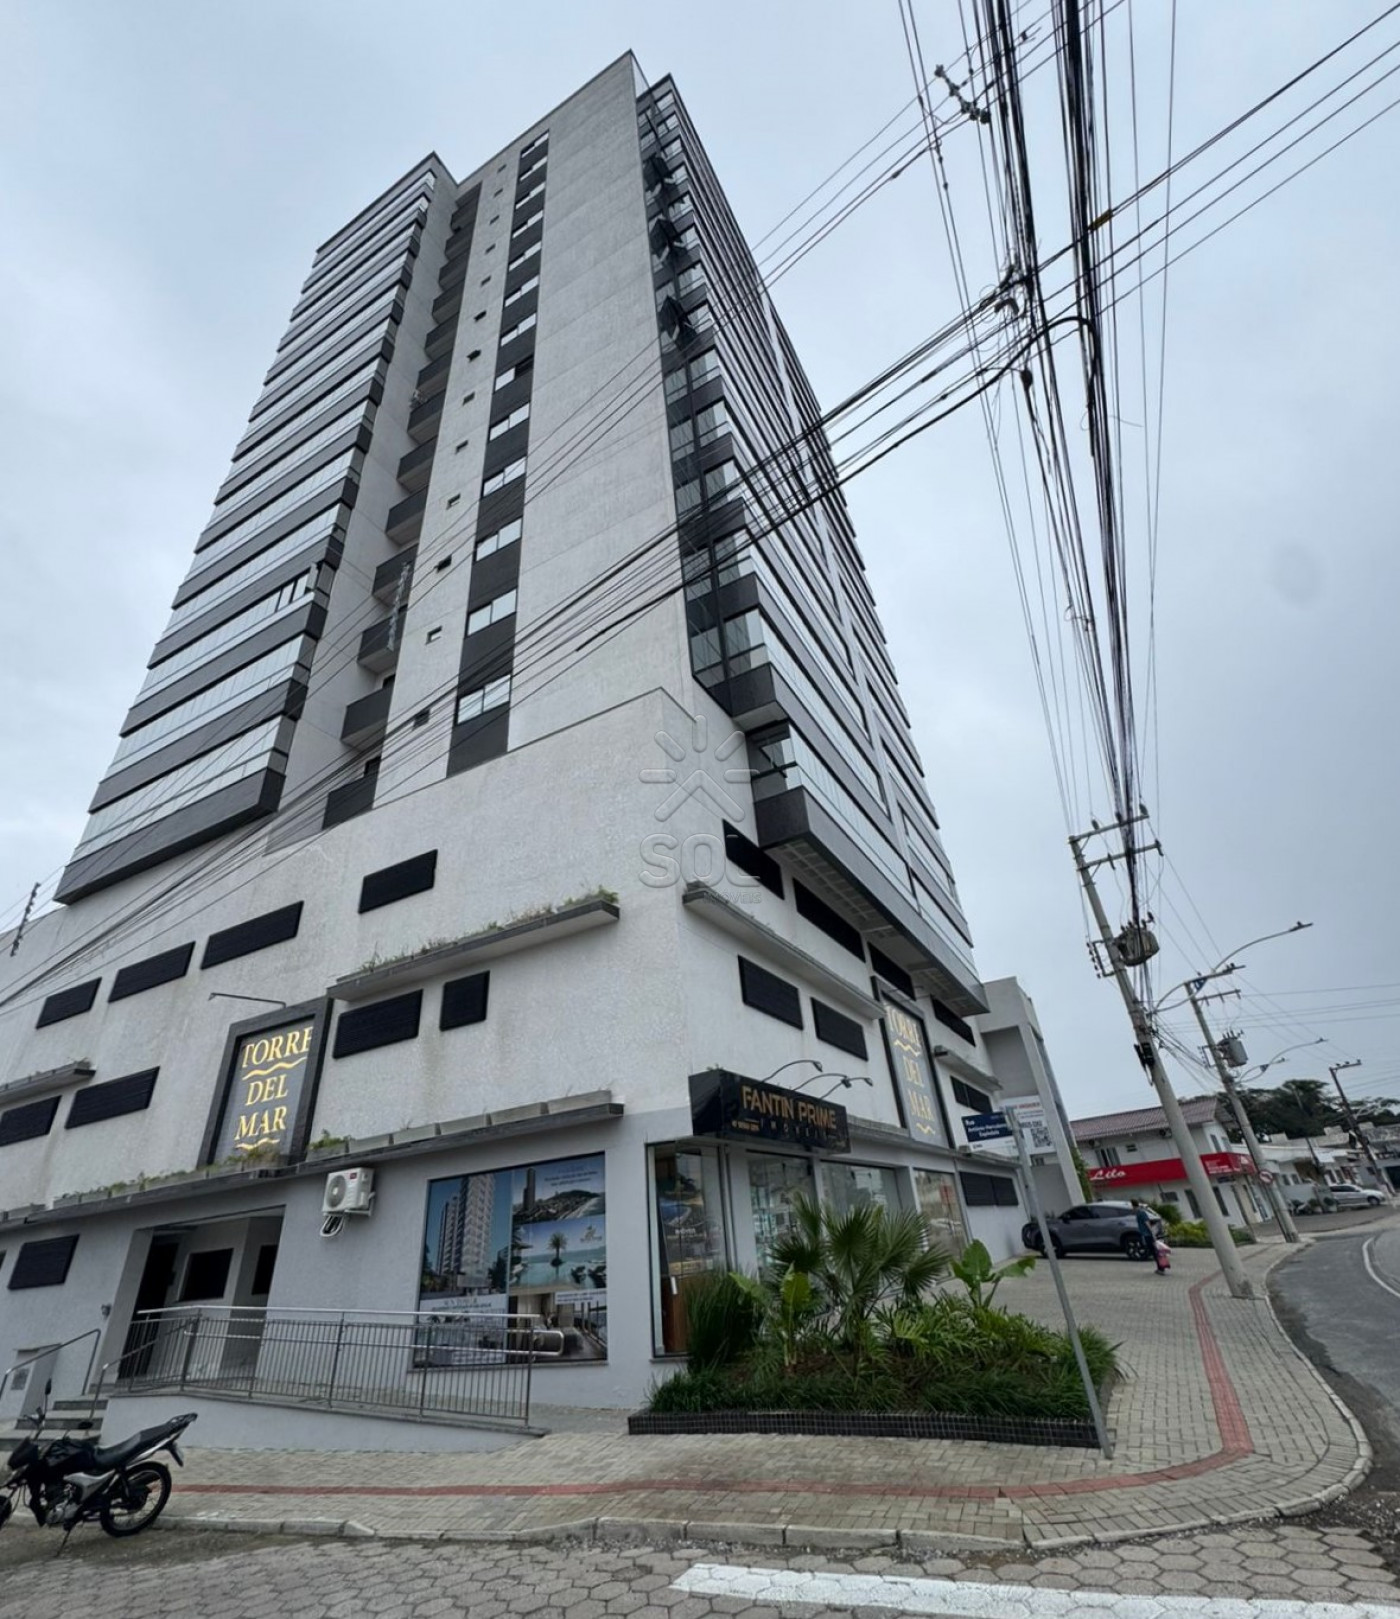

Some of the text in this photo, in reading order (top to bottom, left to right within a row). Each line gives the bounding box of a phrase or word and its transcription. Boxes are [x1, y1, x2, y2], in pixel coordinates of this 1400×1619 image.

[885, 1003, 921, 1048] TORRE
[903, 1056, 925, 1087] DEL
[245, 1074, 288, 1106] DEL
[908, 1088, 935, 1121] MAR
[234, 1106, 287, 1140] MAR
[742, 1085, 837, 1129] FANTIN PRIME
[1090, 1169, 1126, 1180] Lilo
